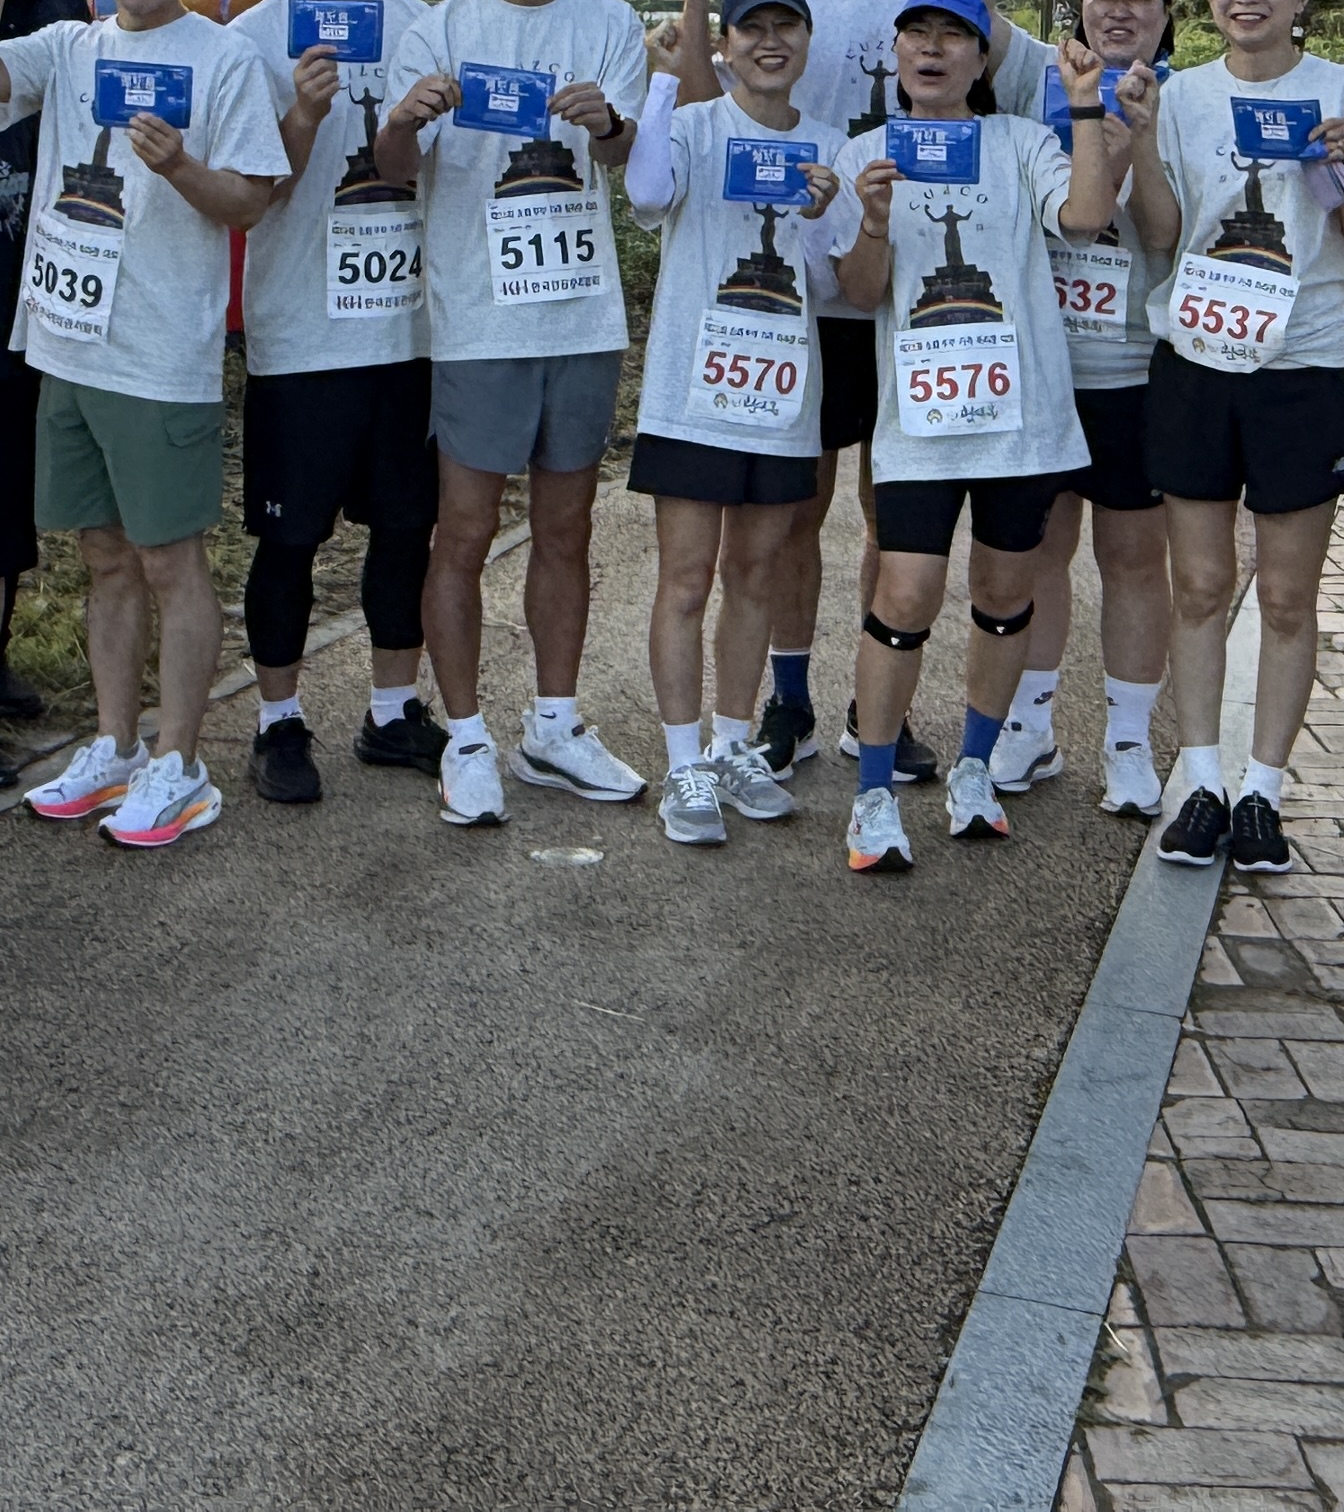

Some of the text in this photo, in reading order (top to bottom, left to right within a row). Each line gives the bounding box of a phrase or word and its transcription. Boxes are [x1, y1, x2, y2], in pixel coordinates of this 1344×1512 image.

[338, 245, 423, 285] 5024
[500, 228, 595, 269] 5115
[31, 253, 104, 308] 5039
[1178, 293, 1278, 343] 5537
[702, 350, 797, 395] 5570
[909, 361, 1010, 403] 5576
